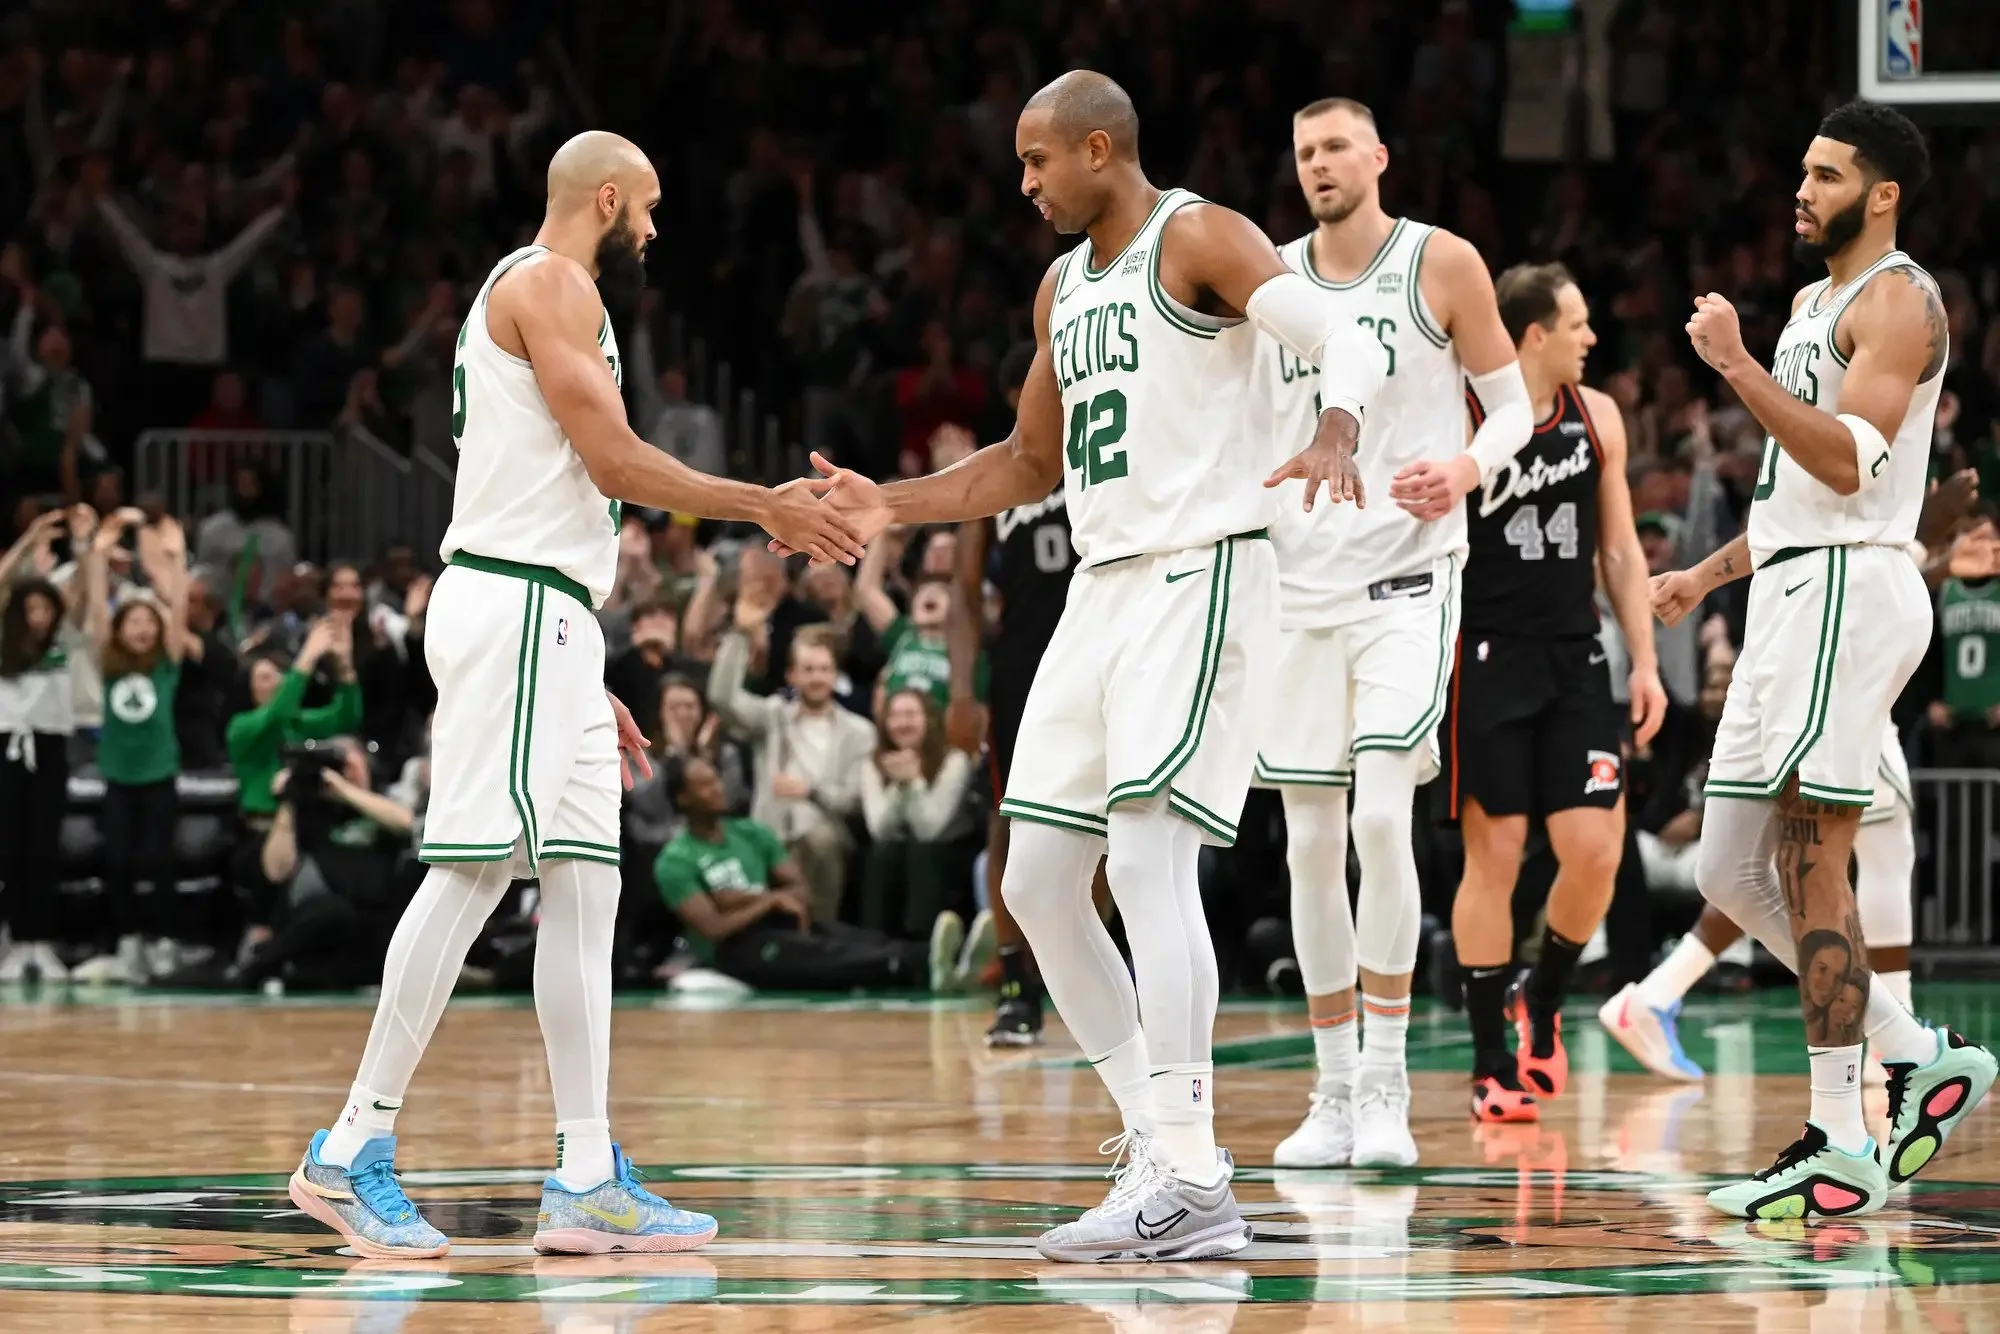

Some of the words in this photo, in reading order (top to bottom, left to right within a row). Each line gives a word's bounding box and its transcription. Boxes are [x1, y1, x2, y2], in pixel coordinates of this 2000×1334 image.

[1121, 263, 1143, 277] PRINT
[1053, 303, 1139, 393] CELTICS
[1066, 389, 1129, 483] 42
[1478, 438, 1591, 518] Detroit
[1033, 524, 1070, 573] 0
[1503, 502, 1579, 560] 44
[1957, 635, 1986, 678] 0
